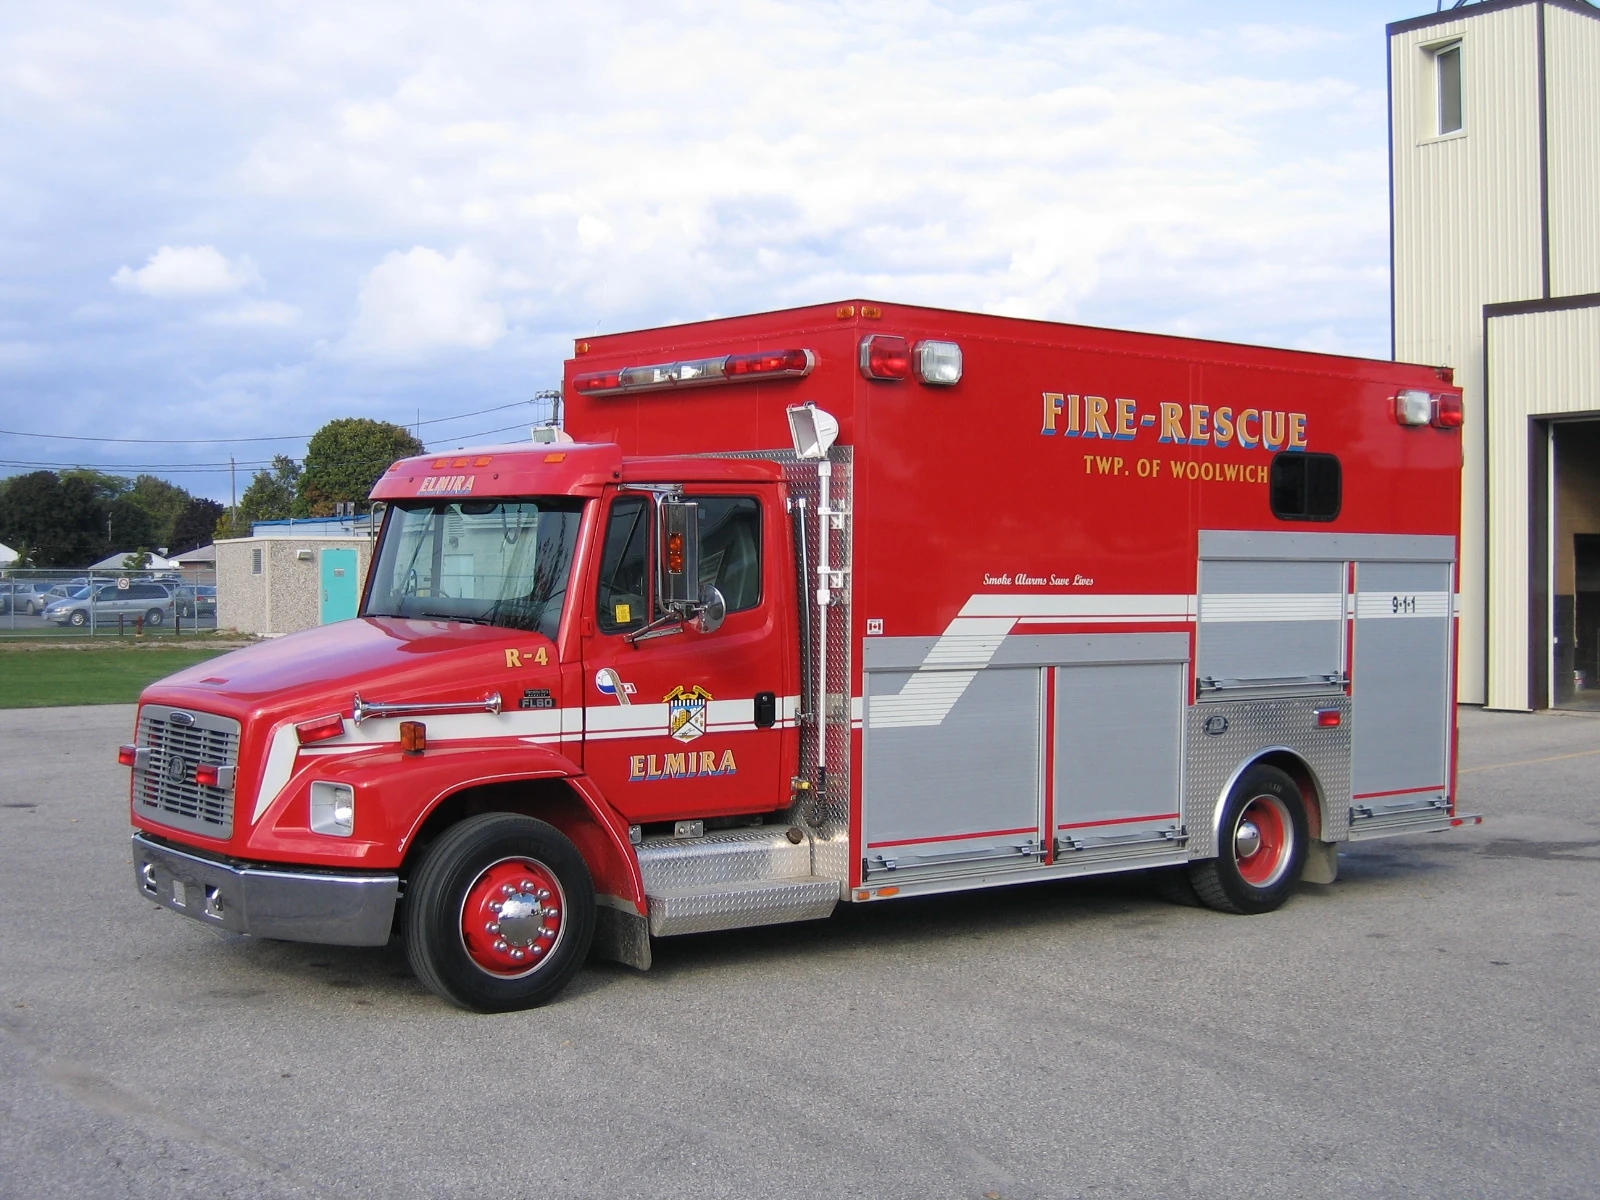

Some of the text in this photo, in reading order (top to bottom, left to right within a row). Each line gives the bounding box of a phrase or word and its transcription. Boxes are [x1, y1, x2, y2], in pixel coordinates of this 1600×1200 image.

[1040, 391, 1308, 451] FIRE-RESCUE
[1083, 455, 1268, 484] TWP. OF WOOLWICH
[416, 475, 475, 496] ELMIRA
[982, 573, 1094, 586] Smoke Alarms Save Lives
[505, 646, 549, 668] R-4
[628, 749, 738, 782] ELMIRA
